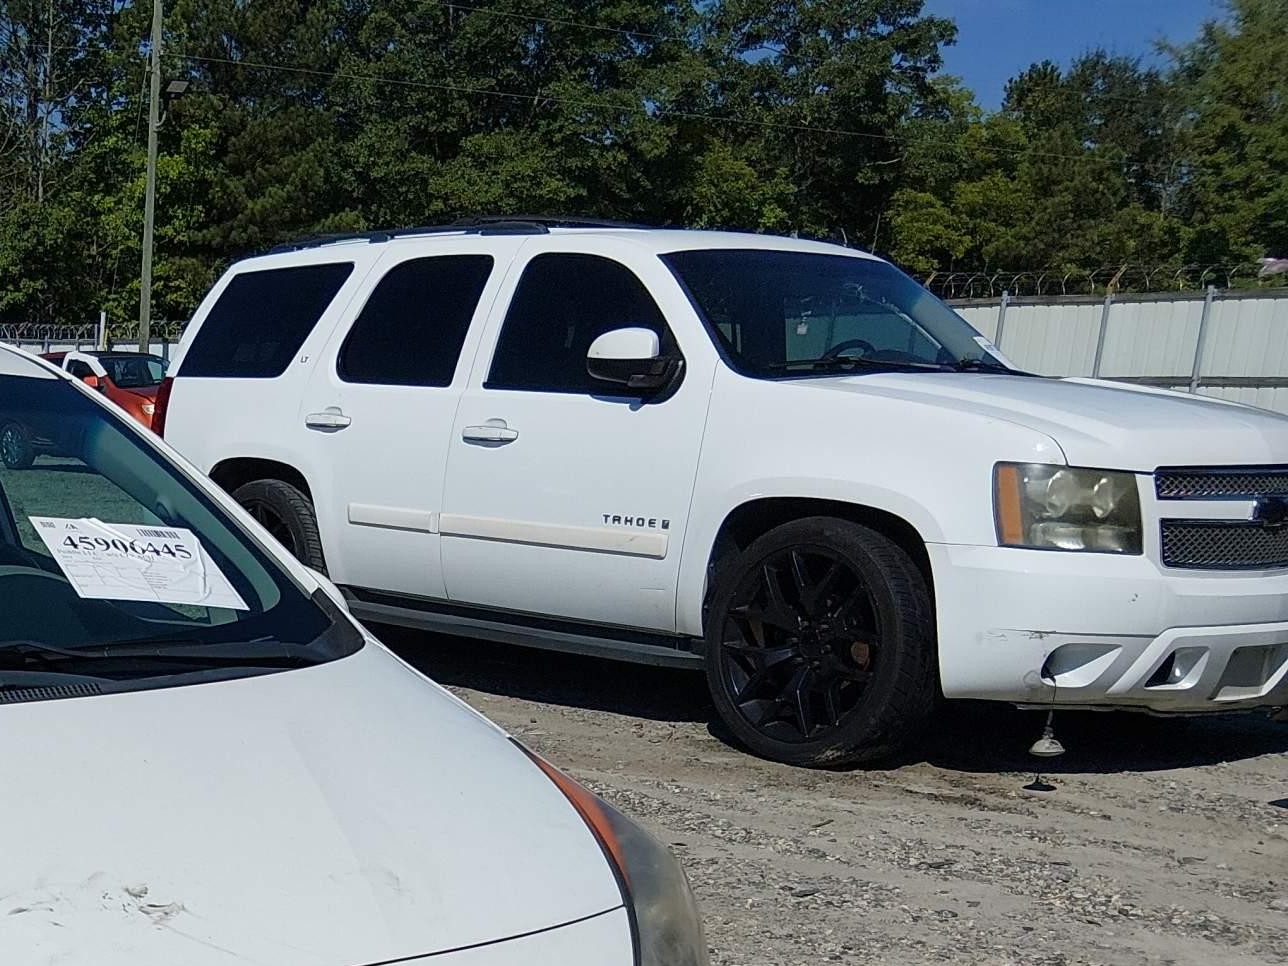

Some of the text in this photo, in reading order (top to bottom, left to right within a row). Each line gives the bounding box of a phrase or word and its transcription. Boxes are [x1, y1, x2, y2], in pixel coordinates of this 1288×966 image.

[300, 355, 309, 363] LT
[602, 513, 657, 528] TAHOE
[63, 535, 192, 560] 45906445
